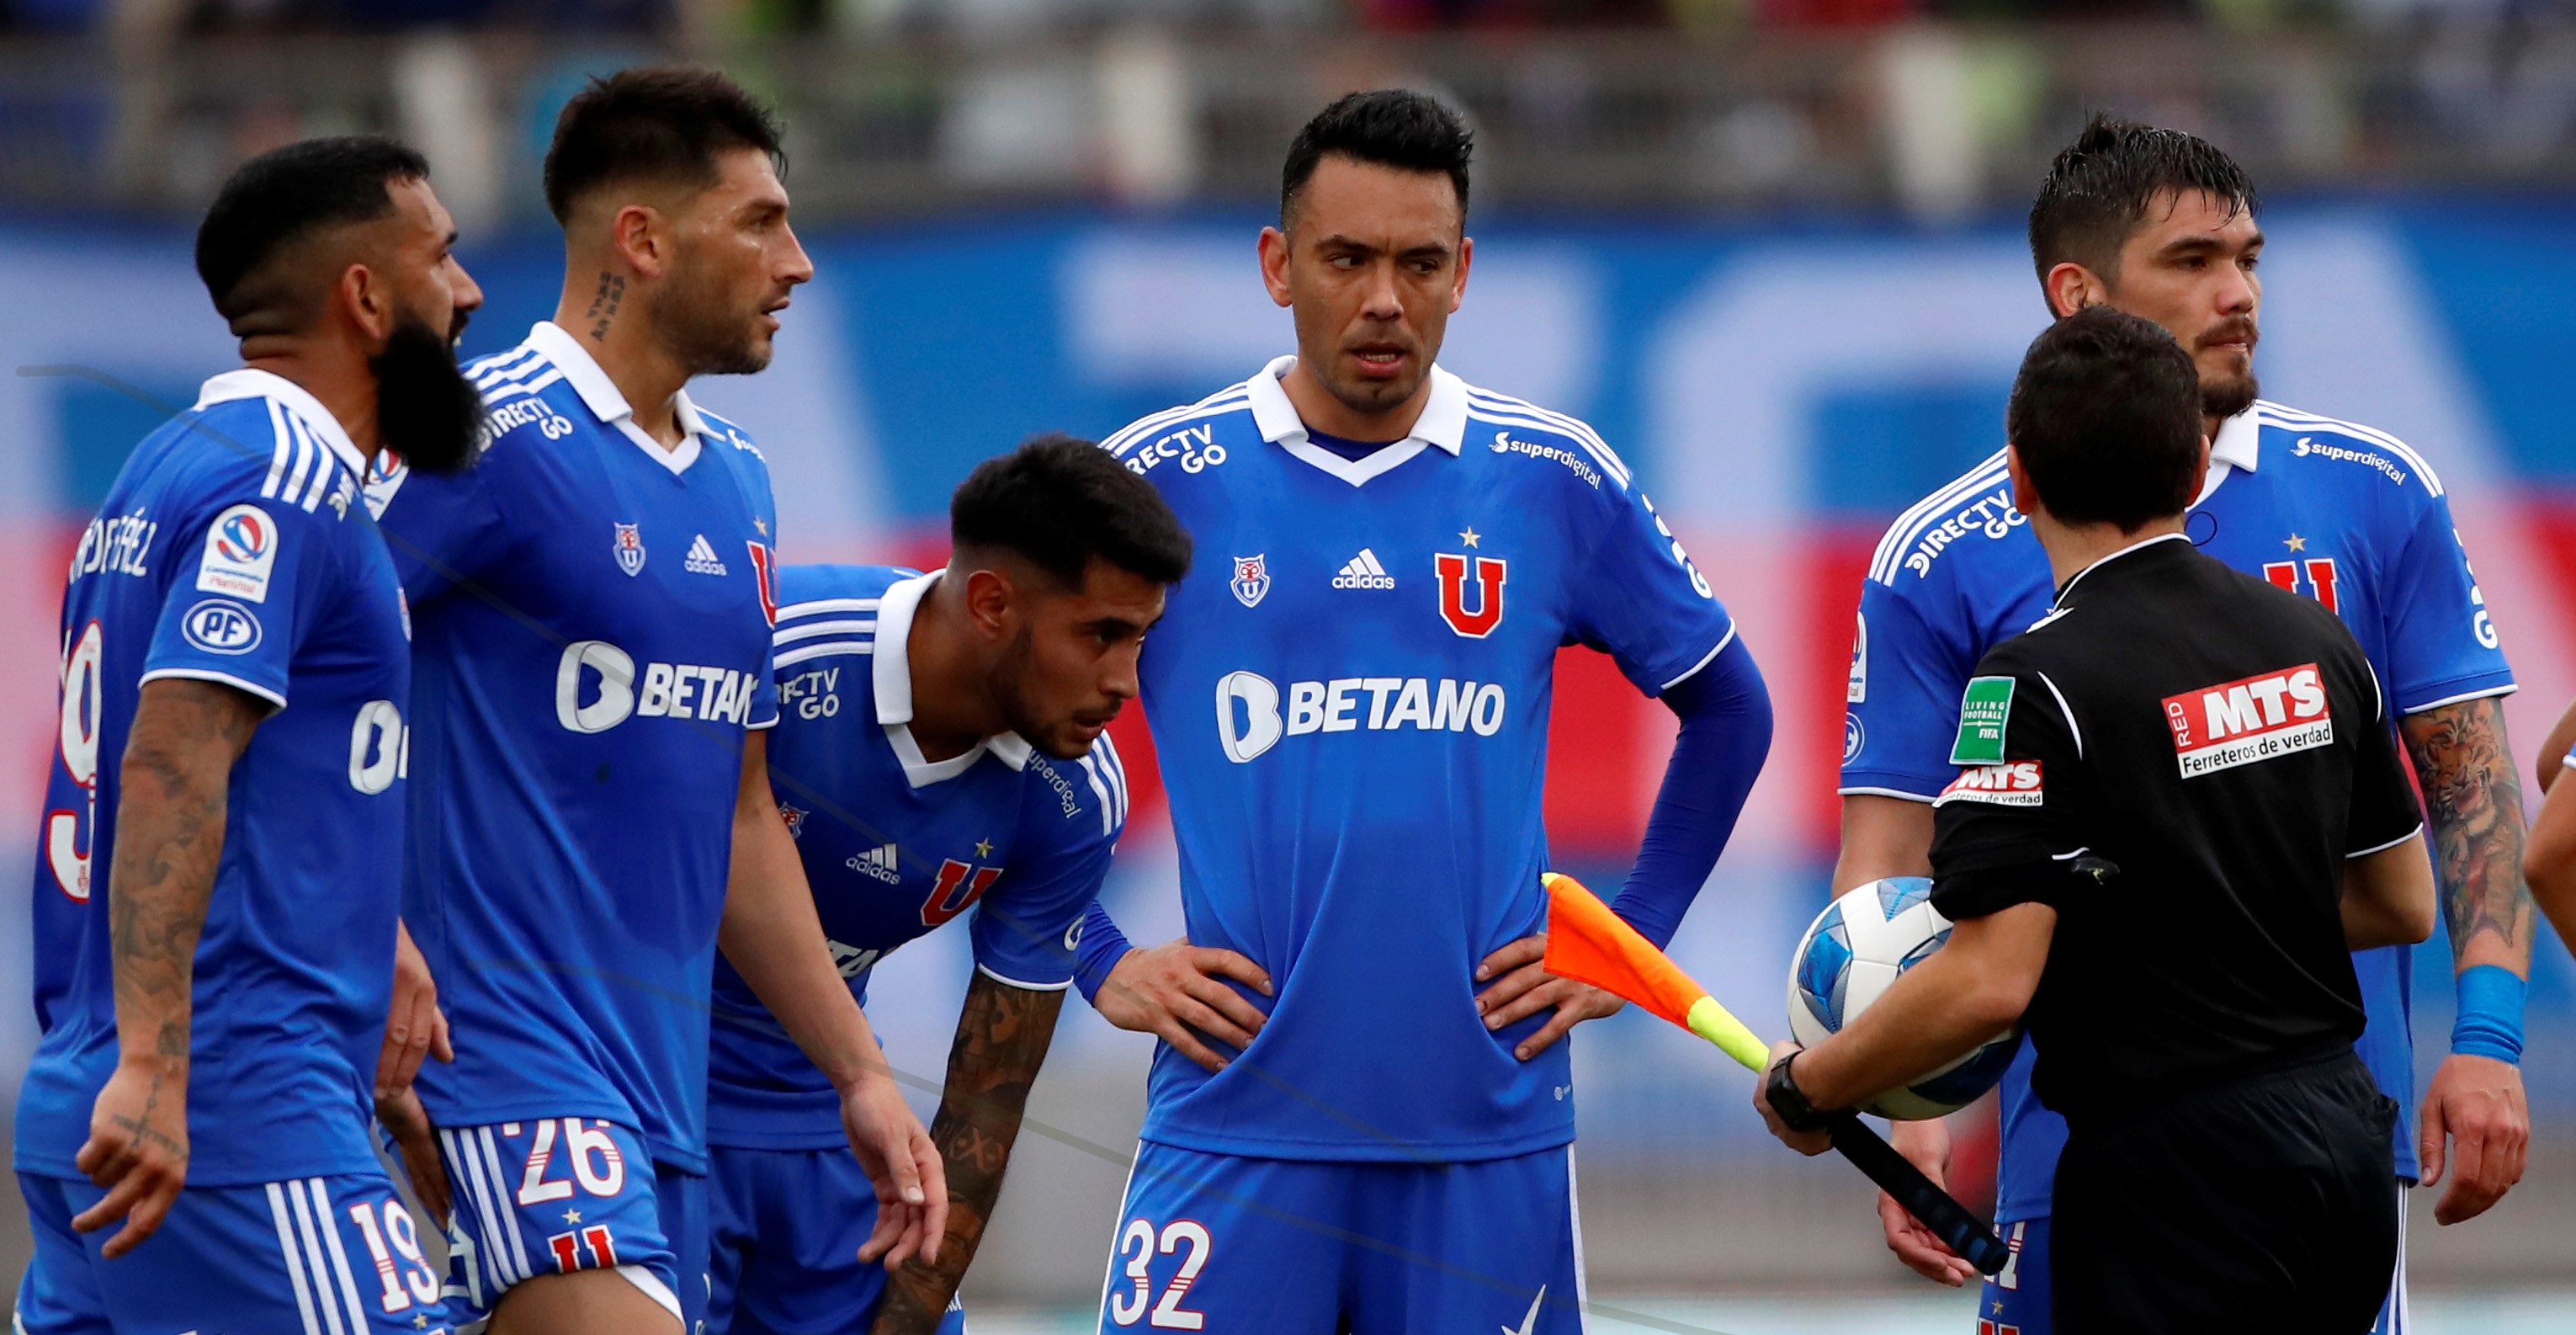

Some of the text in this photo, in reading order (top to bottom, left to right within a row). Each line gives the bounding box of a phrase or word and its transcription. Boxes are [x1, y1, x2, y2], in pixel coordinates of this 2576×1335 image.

[539, 415, 573, 440] GO
[1124, 423, 1211, 475] RECTV
[1181, 444, 1227, 474] GO
[1510, 440, 1601, 490] superdigital
[2311, 443, 2407, 486] superdigital
[1904, 488, 2010, 579] DIRECTV
[1984, 507, 2027, 540] GO
[684, 559, 727, 576] adidas
[1332, 574, 1395, 589] adidas
[1434, 552, 1507, 639] U
[202, 612, 242, 643] PF
[636, 662, 758, 725] BETAN
[799, 694, 840, 720] GO
[1287, 677, 1505, 737] BETANO
[1964, 710, 2002, 719] FOOTBALL
[1965, 701, 2005, 710] LIVING
[2202, 670, 2325, 741] MTS
[1978, 728, 1999, 739] FIFA
[2168, 701, 2193, 747] RED
[2182, 723, 2330, 774] Ferreteros de verdad
[1956, 763, 2041, 789] MTS
[2001, 793, 2041, 804] verdad
[846, 856, 900, 884] adidas
[920, 858, 1004, 926] U
[502, 1117, 625, 1206] 26
[349, 1198, 441, 1314] 19
[1111, 1218, 1213, 1331] 32
